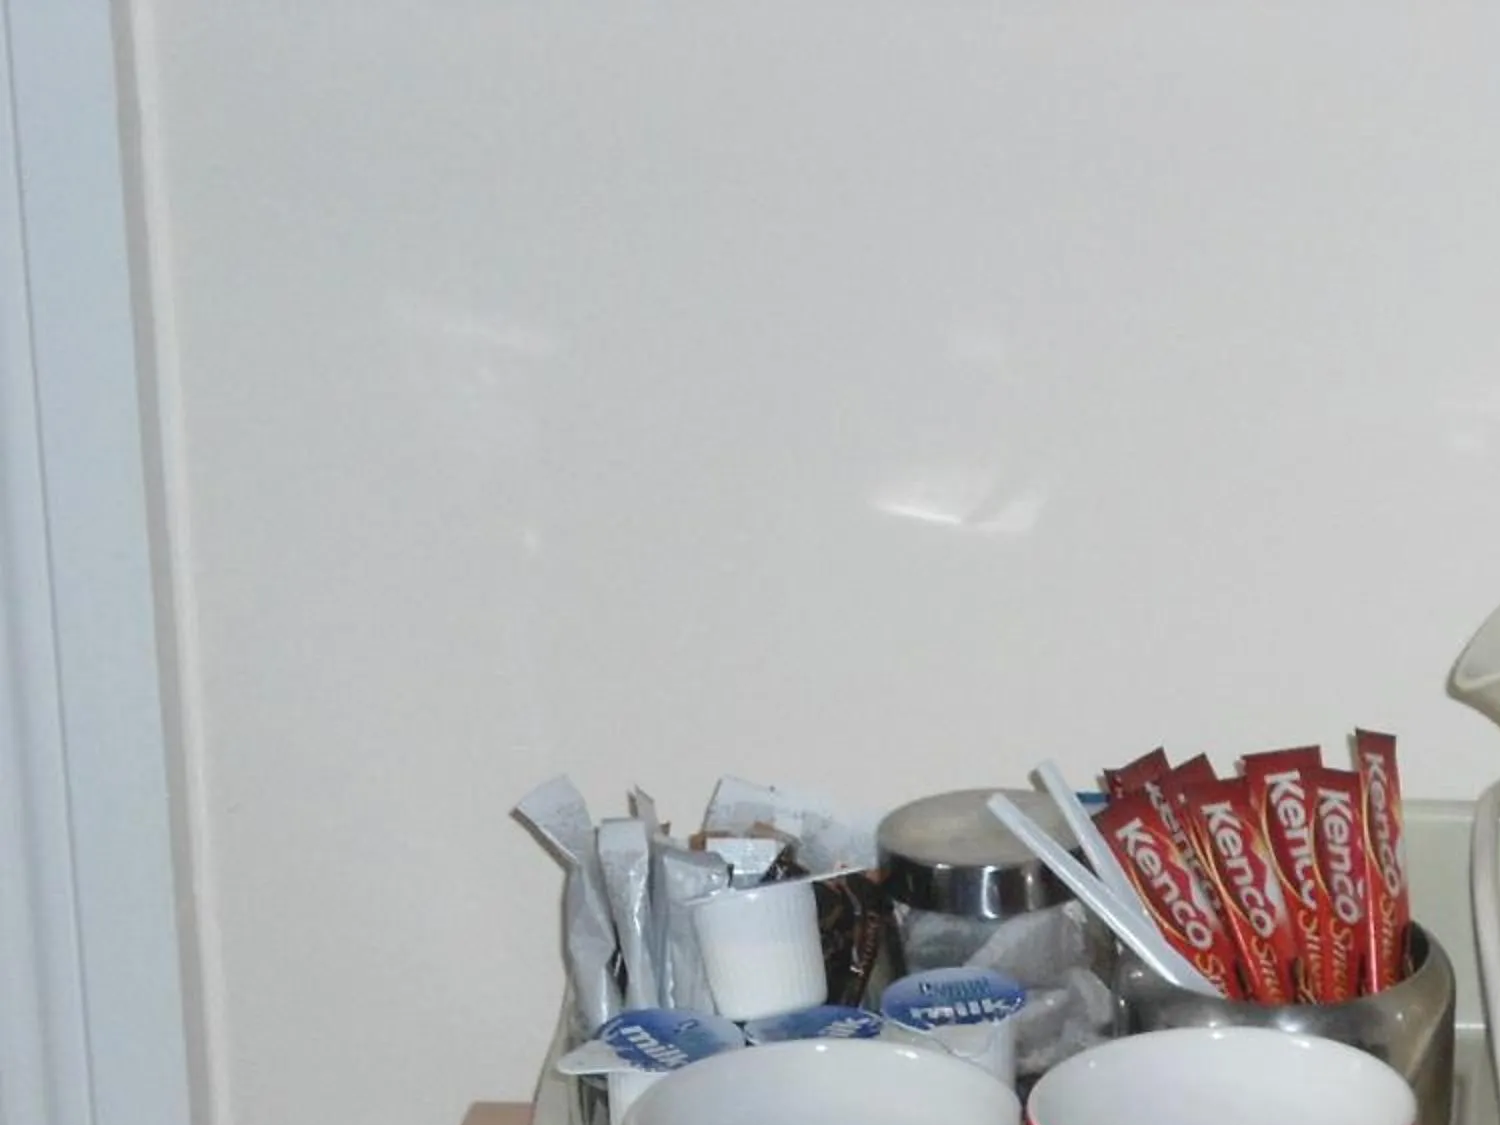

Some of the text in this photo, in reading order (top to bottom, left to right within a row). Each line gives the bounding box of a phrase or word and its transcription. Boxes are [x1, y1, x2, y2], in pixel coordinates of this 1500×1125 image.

[1116, 817, 1213, 949] Kenco
[1200, 799, 1275, 939] Kenco
[1318, 788, 1363, 925] Kenco
[1363, 753, 1400, 898] Kenco
[909, 998, 1010, 1020] milk
